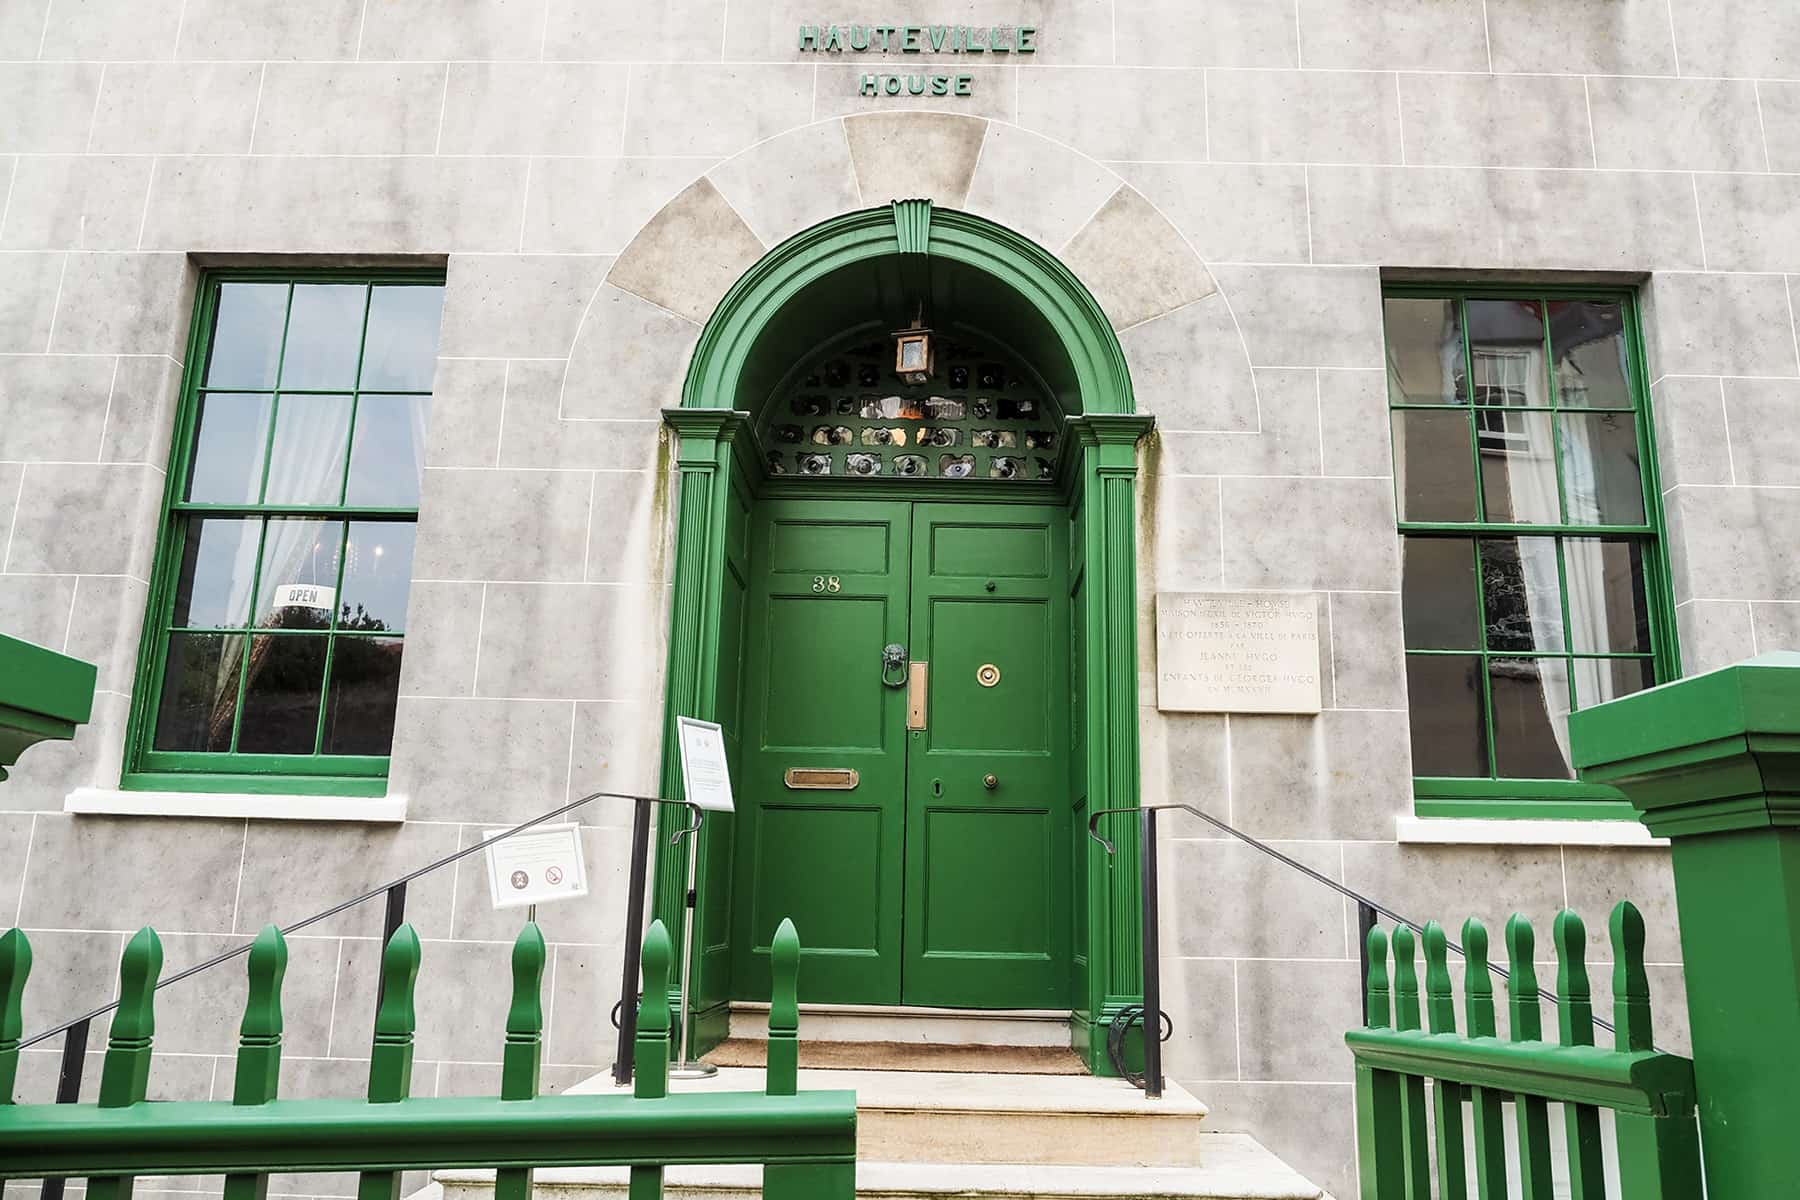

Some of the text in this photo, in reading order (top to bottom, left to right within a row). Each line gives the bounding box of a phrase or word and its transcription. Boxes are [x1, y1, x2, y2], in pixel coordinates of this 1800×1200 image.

[798, 25, 1036, 53] HAUTEVILLE
[860, 74, 973, 96] HOUSE
[812, 575, 841, 593] 38
[289, 589, 318, 603] OPEN
